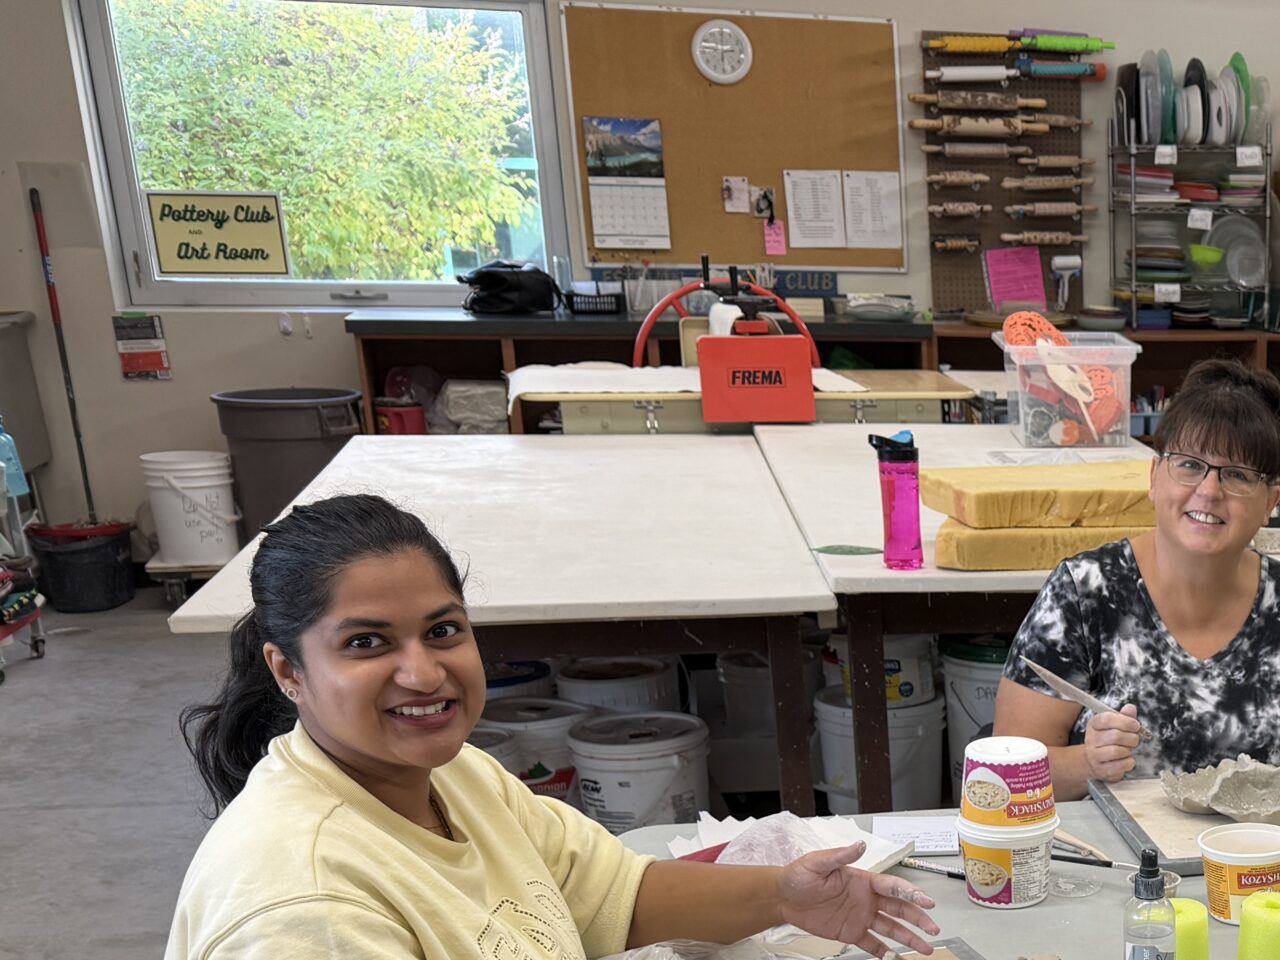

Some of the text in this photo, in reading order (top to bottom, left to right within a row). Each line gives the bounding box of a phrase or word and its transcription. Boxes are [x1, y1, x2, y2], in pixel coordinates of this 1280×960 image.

[160, 203, 275, 229] Pottery Club
[177, 242, 269, 260] Art Room
[785, 273, 833, 291] CLUB
[731, 370, 782, 385] FREMA
